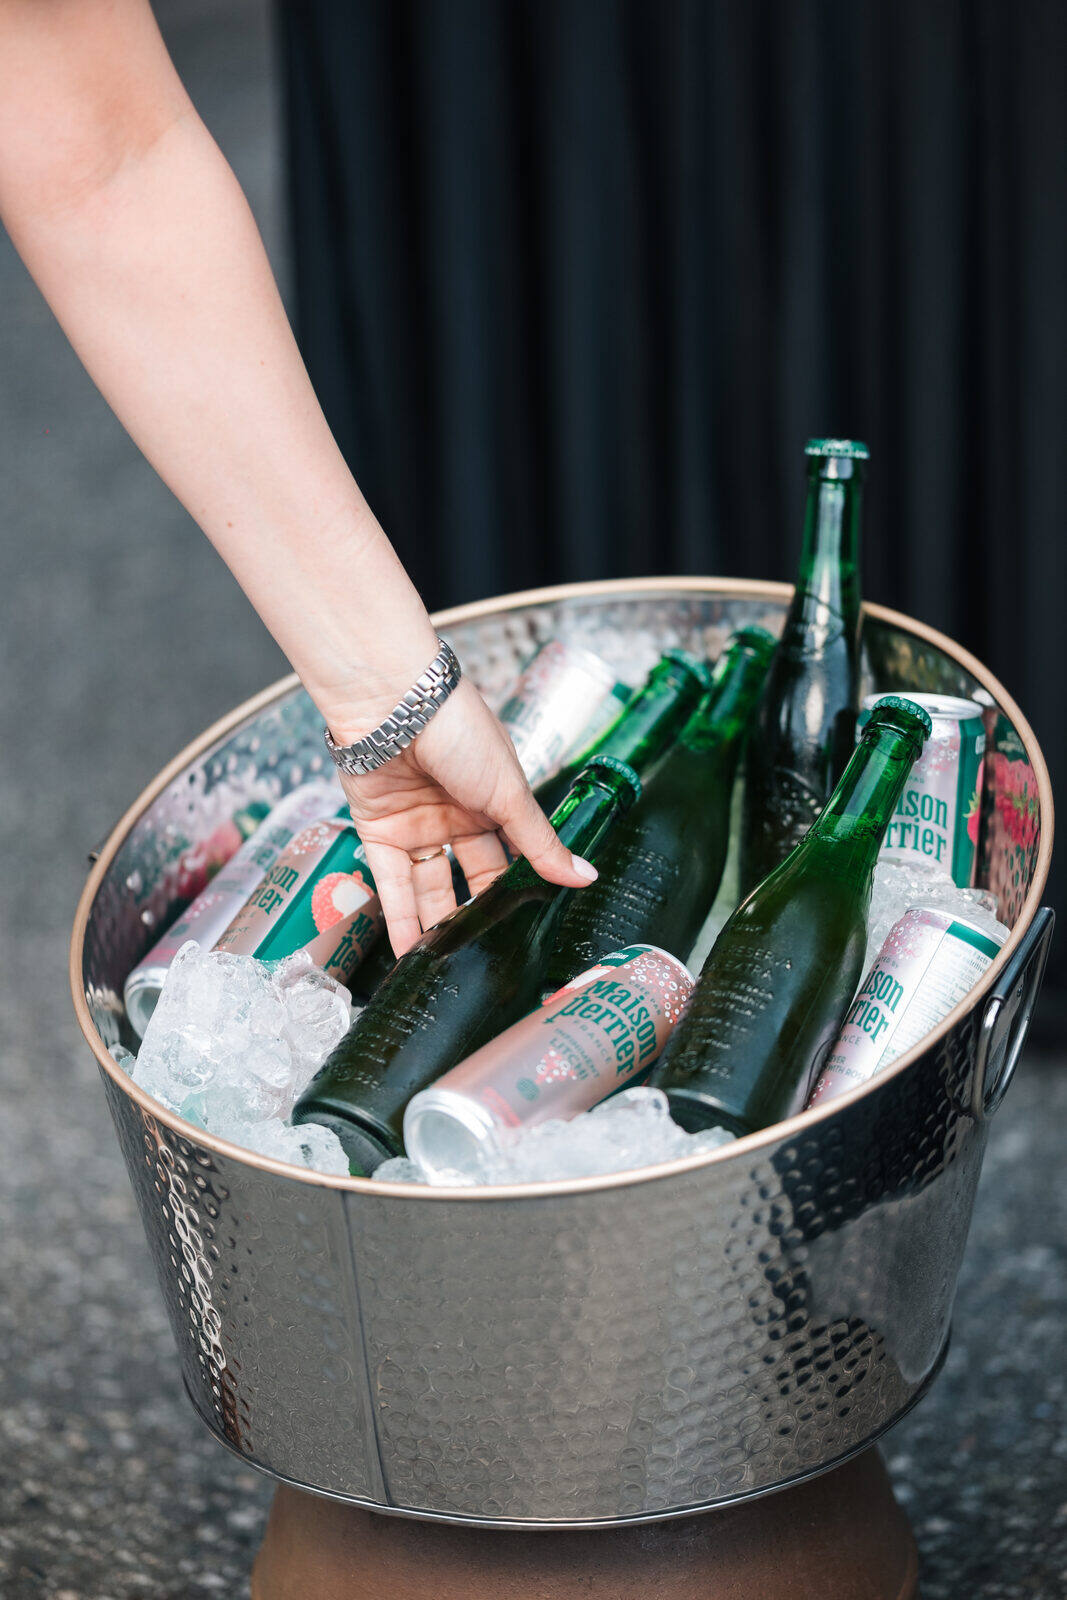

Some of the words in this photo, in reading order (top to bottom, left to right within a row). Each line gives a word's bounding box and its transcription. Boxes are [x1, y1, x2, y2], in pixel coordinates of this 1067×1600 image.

[894, 789, 948, 830] ison
[884, 818, 947, 863] rrier
[860, 963, 904, 1014] ison
[573, 1018, 613, 1064] FRANCE
[581, 980, 657, 1063] Maison
[549, 1036, 590, 1081] LITCHI
